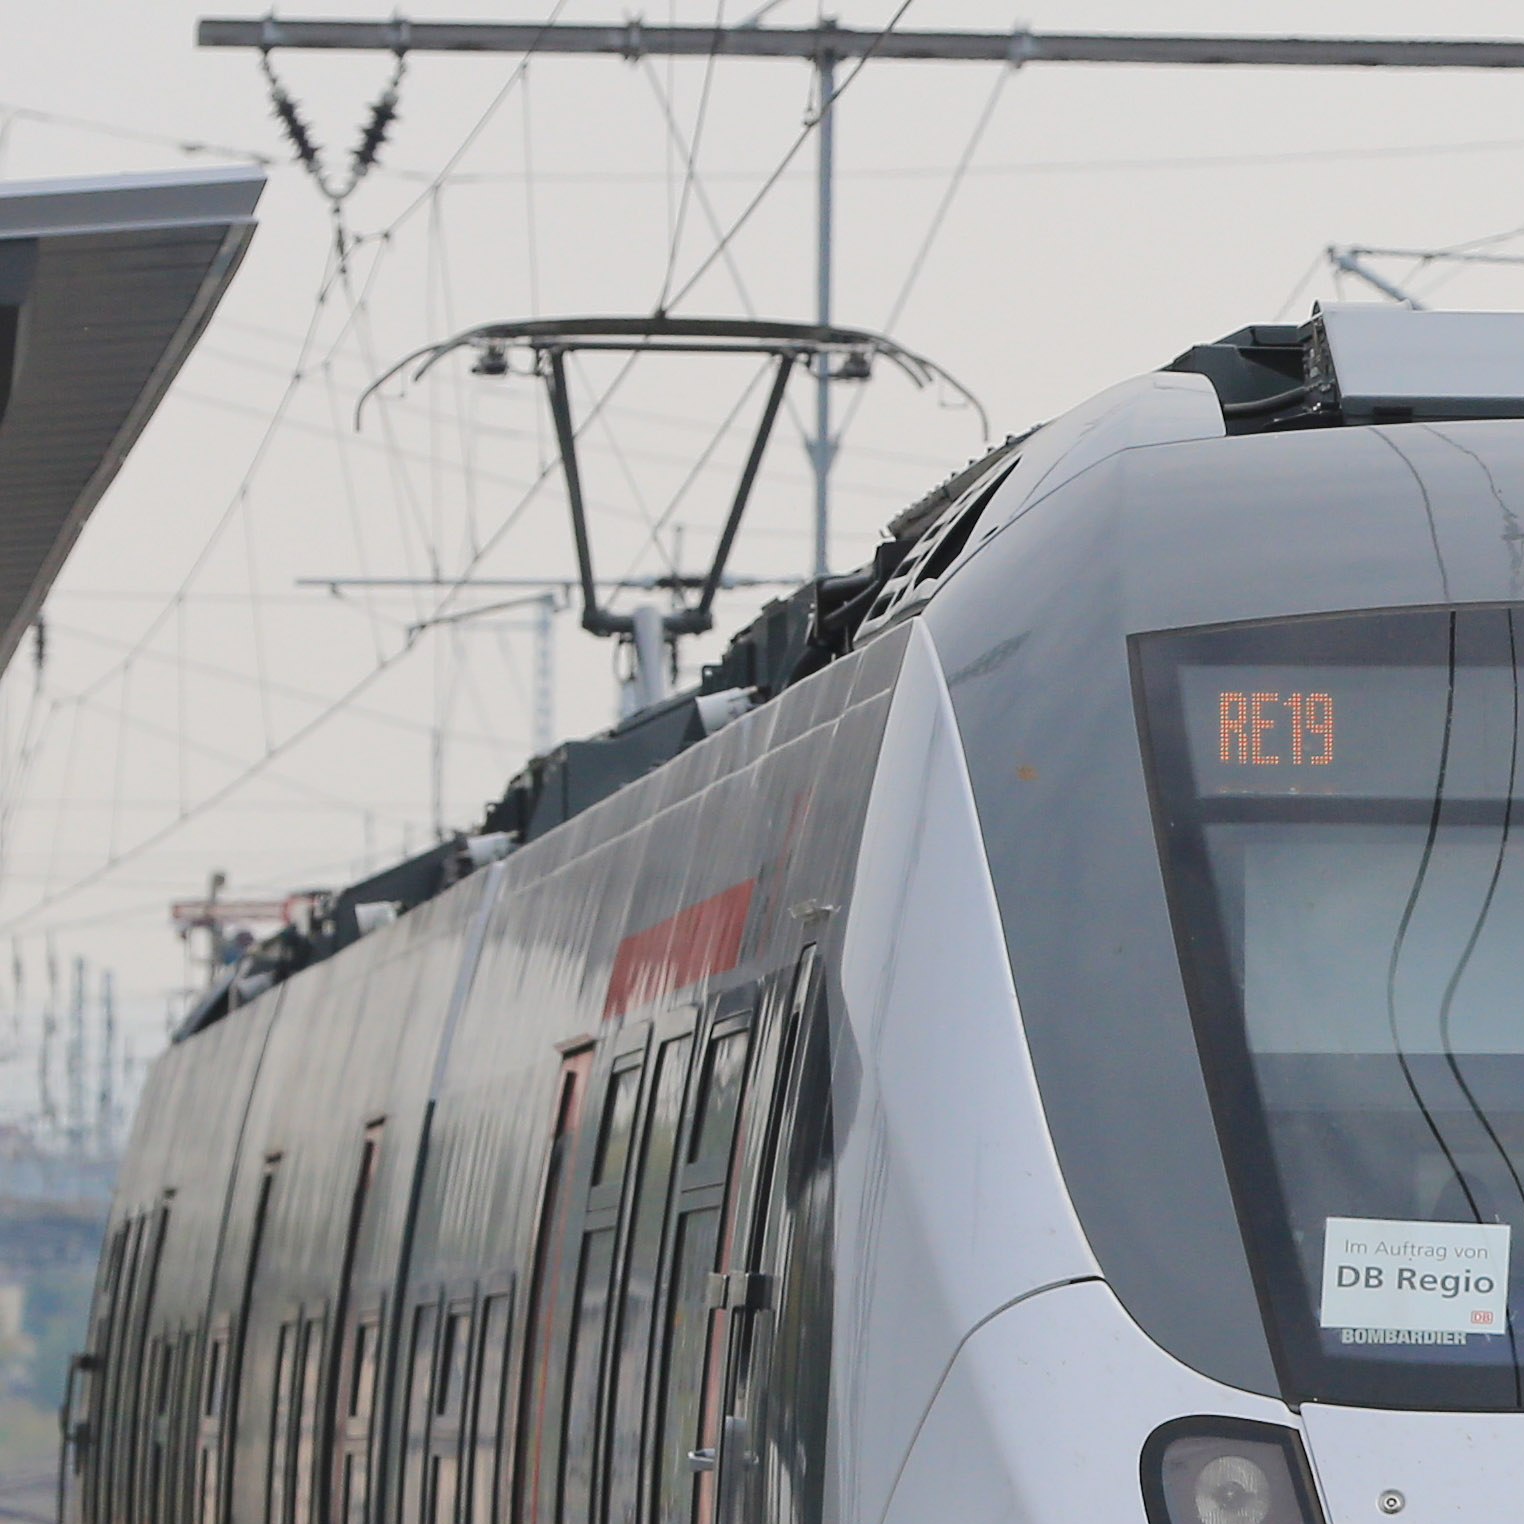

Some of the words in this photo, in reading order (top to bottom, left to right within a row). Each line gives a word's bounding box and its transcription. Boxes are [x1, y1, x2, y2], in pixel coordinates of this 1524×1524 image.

[1218, 692, 1334, 765] RE19
[1344, 1239, 1368, 1255] Im
[1374, 1240, 1448, 1261] Auftrag
[1454, 1247, 1489, 1260] von
[1336, 1265, 1384, 1290] DB
[1396, 1267, 1495, 1299] Regio
[1472, 1312, 1491, 1323] DB
[1341, 1328, 1468, 1345] BOMBARDIER
